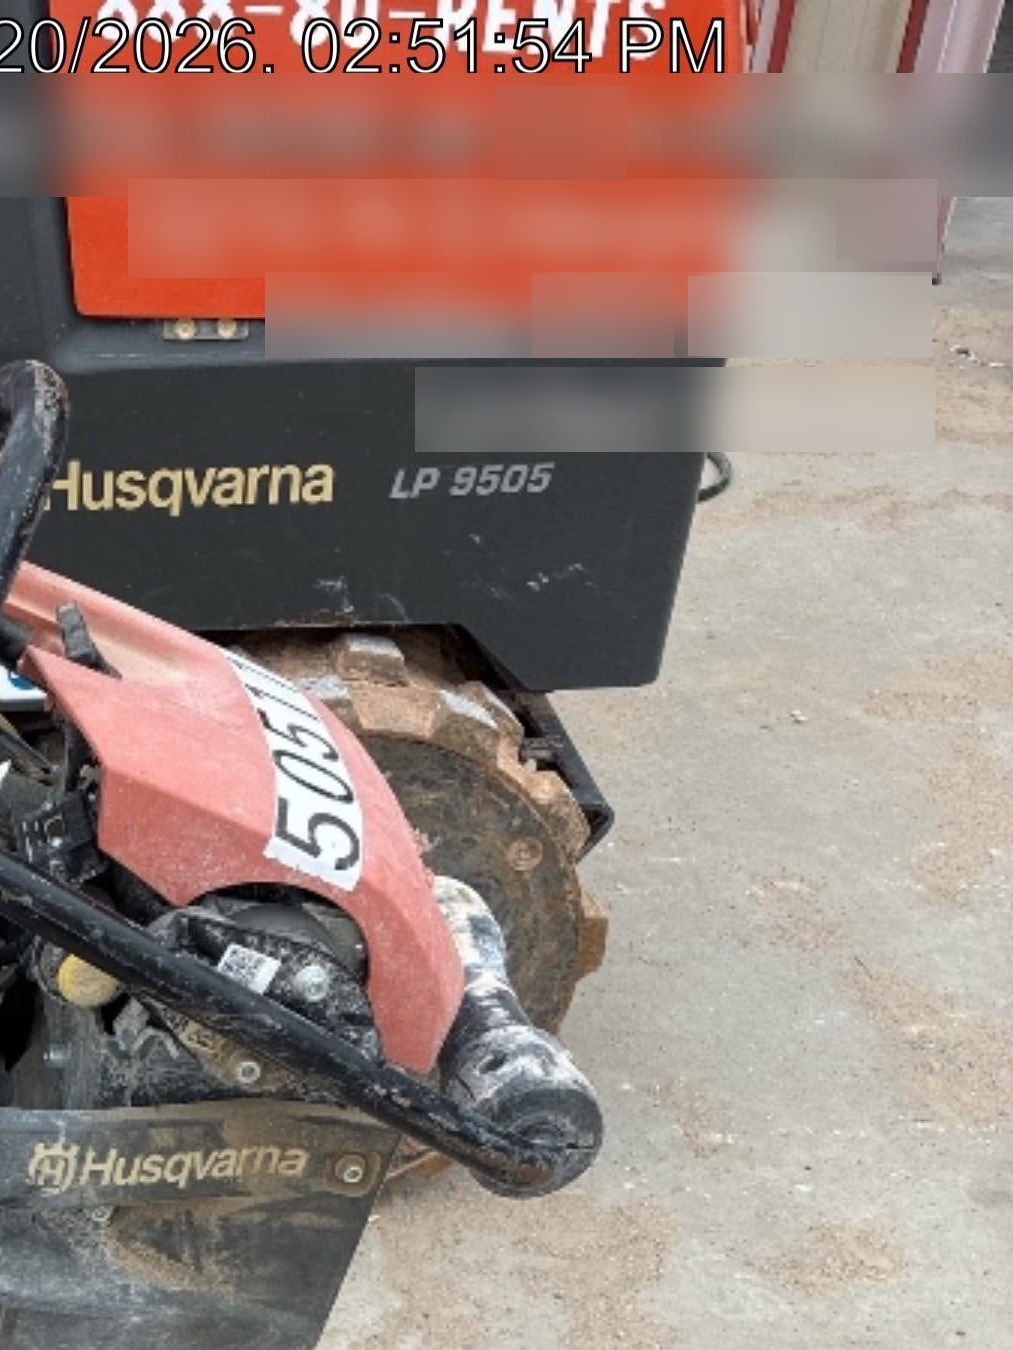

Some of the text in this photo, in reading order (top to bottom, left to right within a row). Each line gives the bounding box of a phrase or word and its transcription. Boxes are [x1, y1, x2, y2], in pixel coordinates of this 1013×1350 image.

[42, 459, 334, 517] Husqvarna
[389, 461, 556, 499] LP 9505
[79, 1143, 309, 1189] Husqvarna
